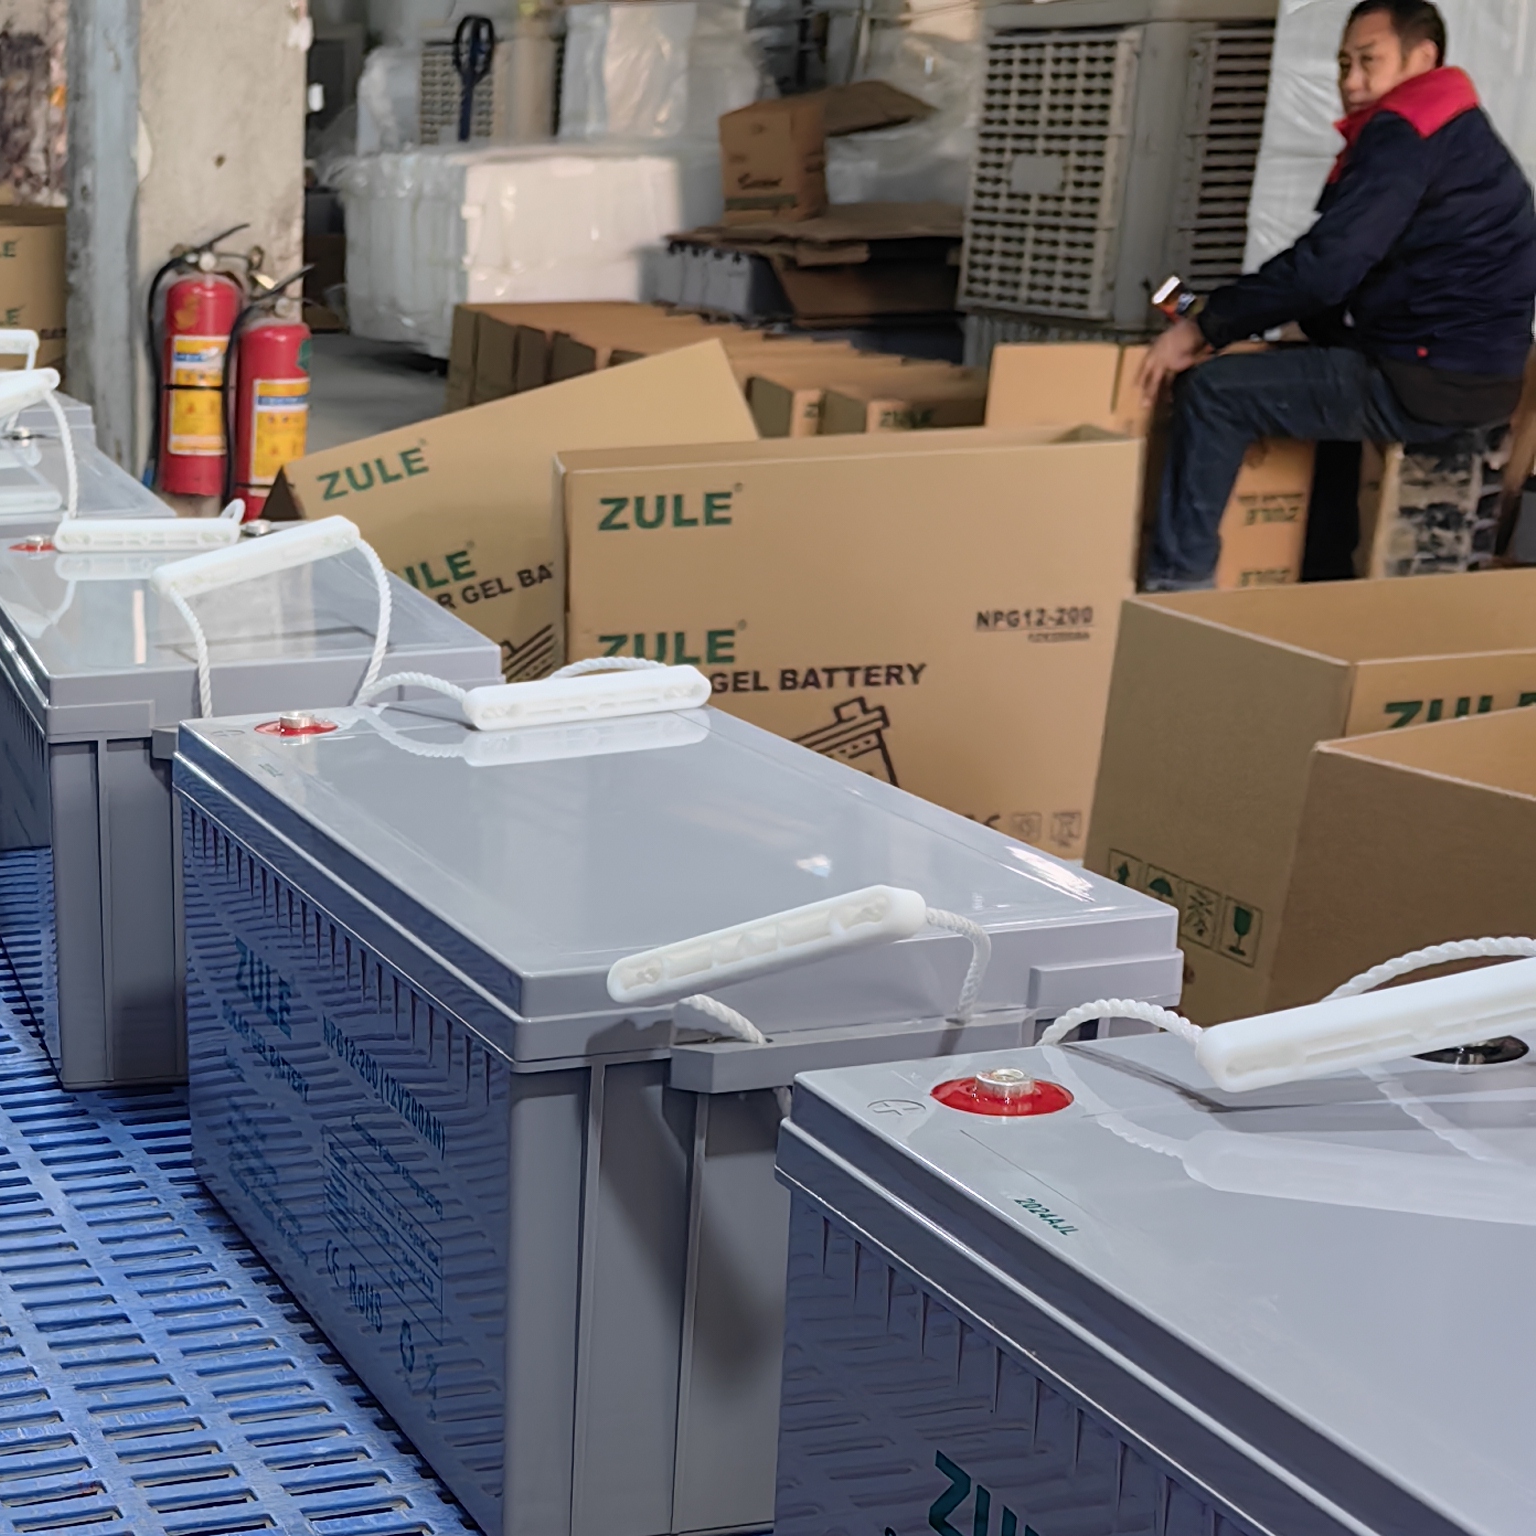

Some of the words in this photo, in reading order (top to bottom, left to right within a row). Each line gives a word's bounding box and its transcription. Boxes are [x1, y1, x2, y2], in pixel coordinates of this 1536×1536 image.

[316, 448, 429, 500] ZULE
[598, 491, 732, 531] ZULE
[462, 576, 513, 605] GEL
[976, 606, 1094, 629] NPG12-200
[598, 629, 736, 665] ZULE
[710, 671, 769, 694] GEL
[779, 663, 927, 691] BATTERY
